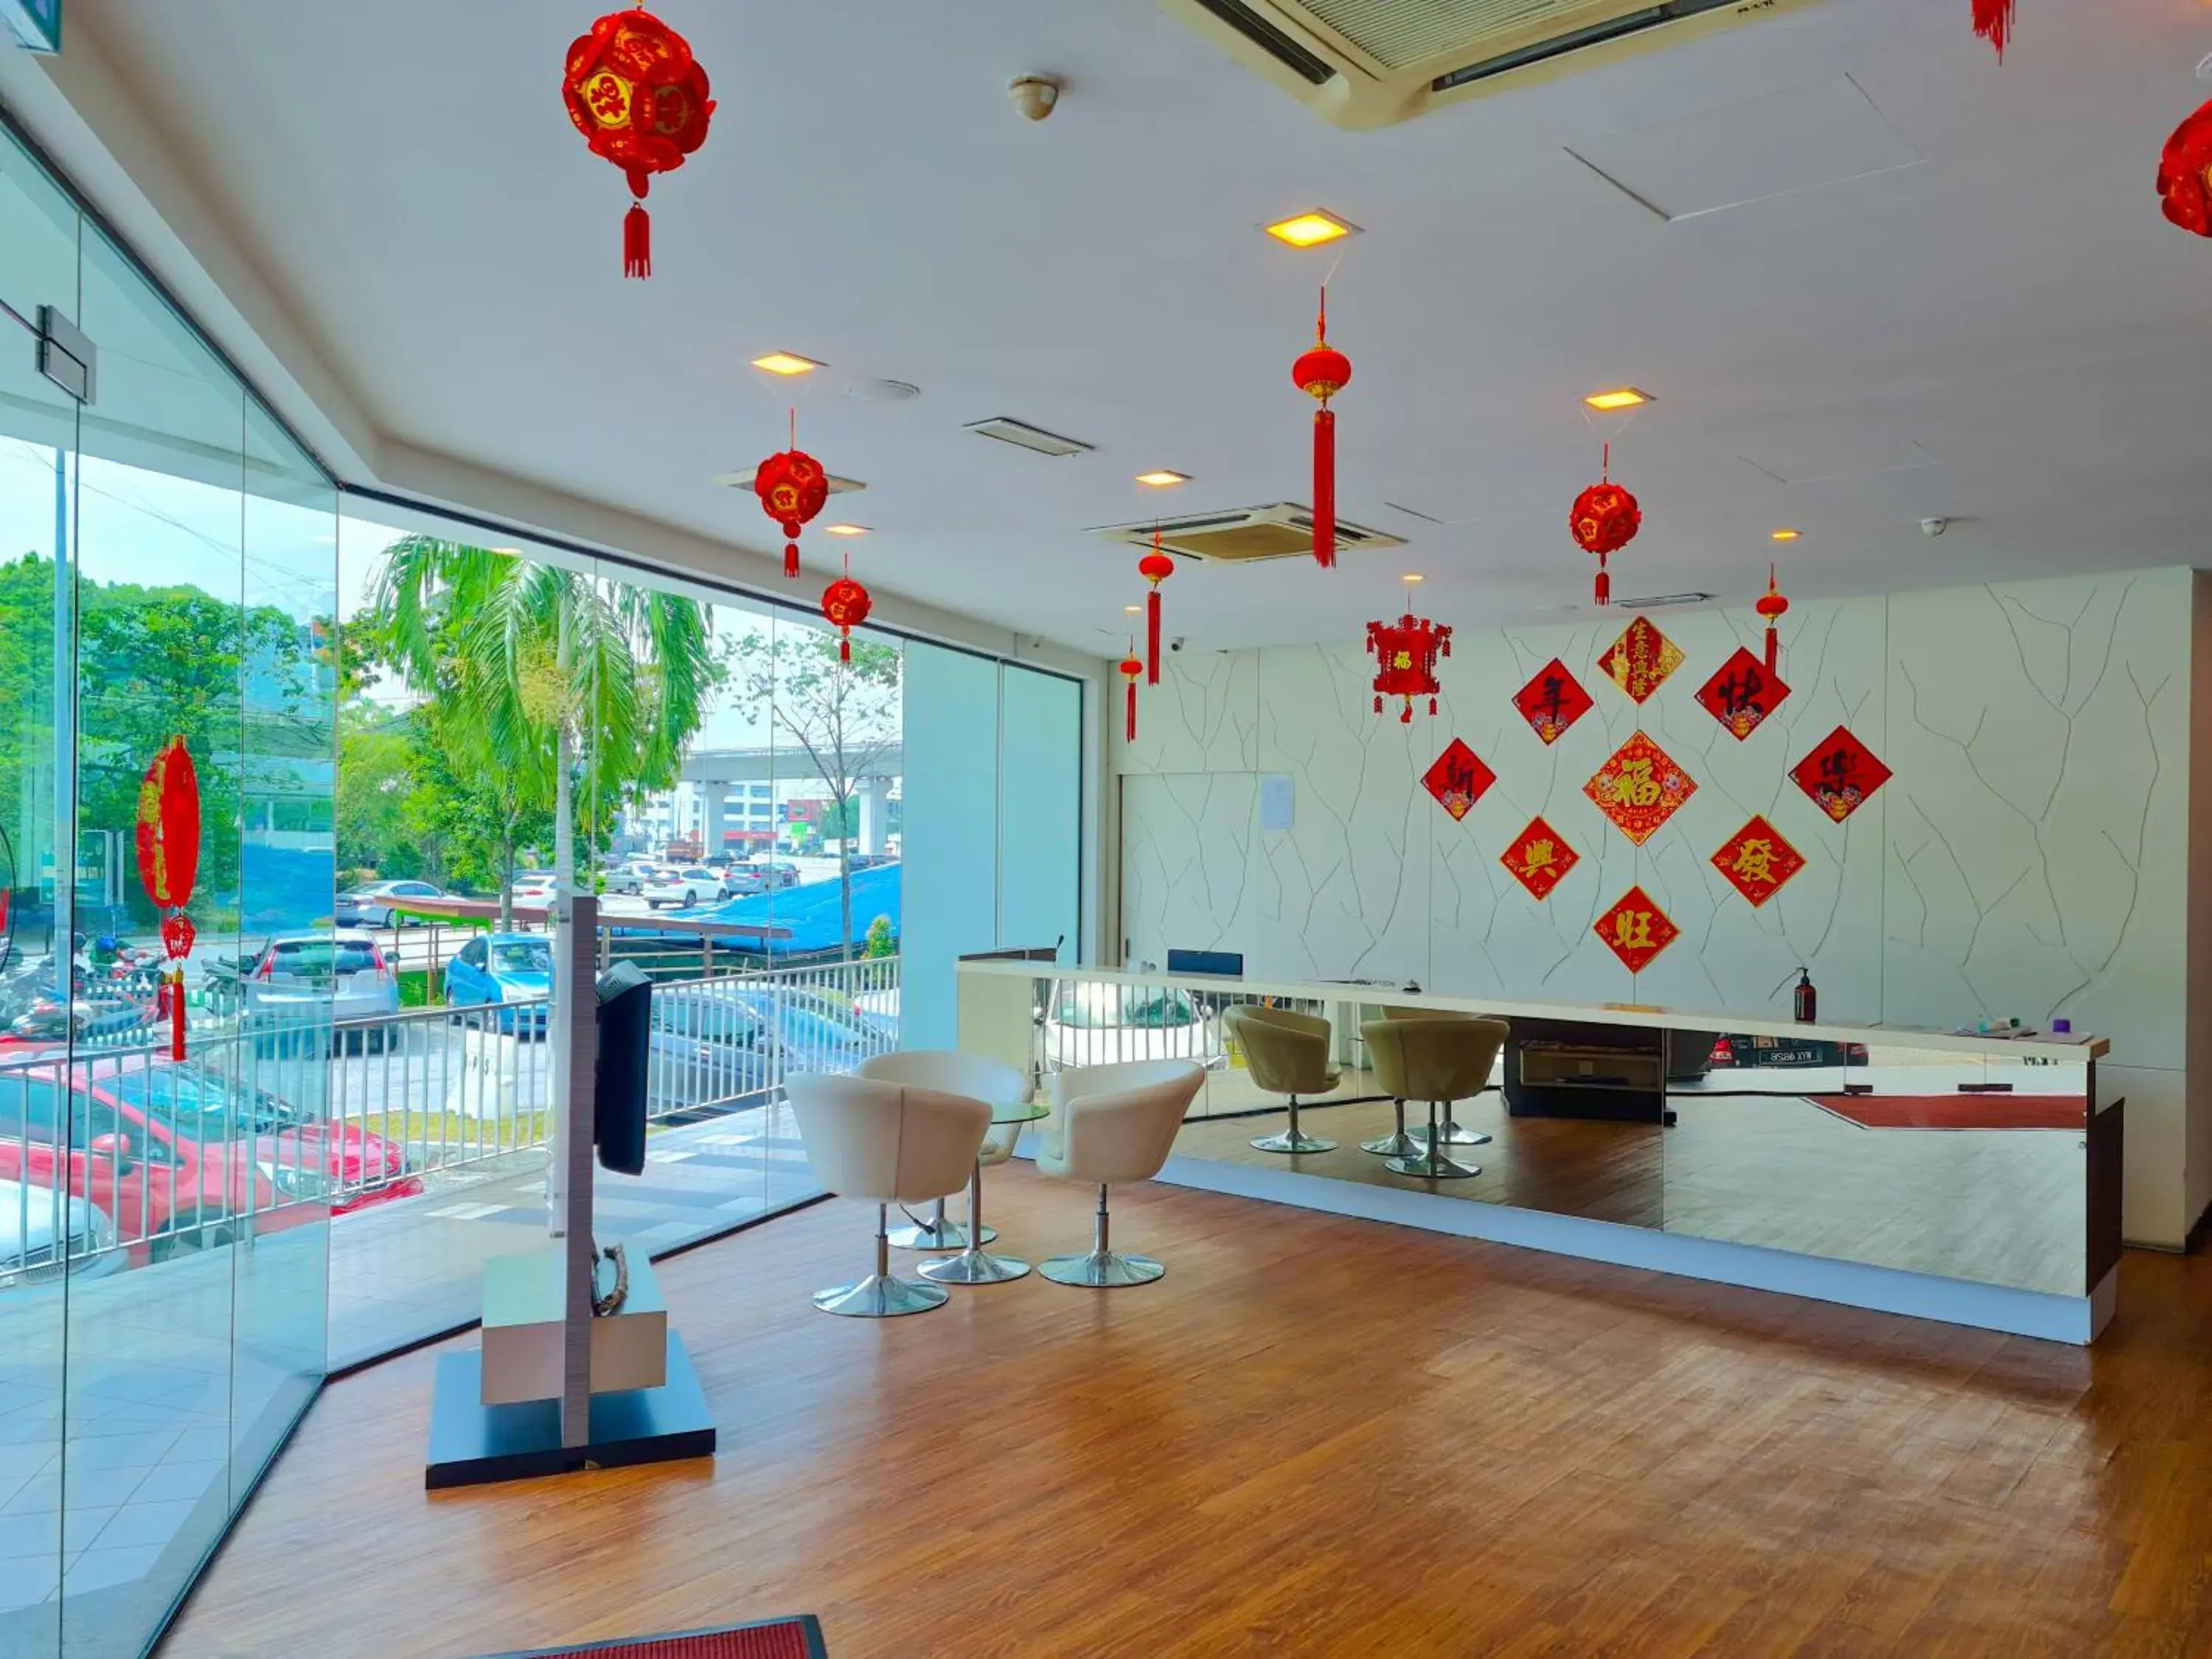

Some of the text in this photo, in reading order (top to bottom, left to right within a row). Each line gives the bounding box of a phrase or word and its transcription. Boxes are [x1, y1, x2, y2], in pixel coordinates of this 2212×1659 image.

[1531, 675, 1571, 726] 年
[1717, 666, 1764, 717] 快
[1438, 754, 1475, 803] 新
[1613, 757, 1662, 807] 福
[1732, 838, 1778, 884] 發
[1613, 909, 1658, 950] 旺
